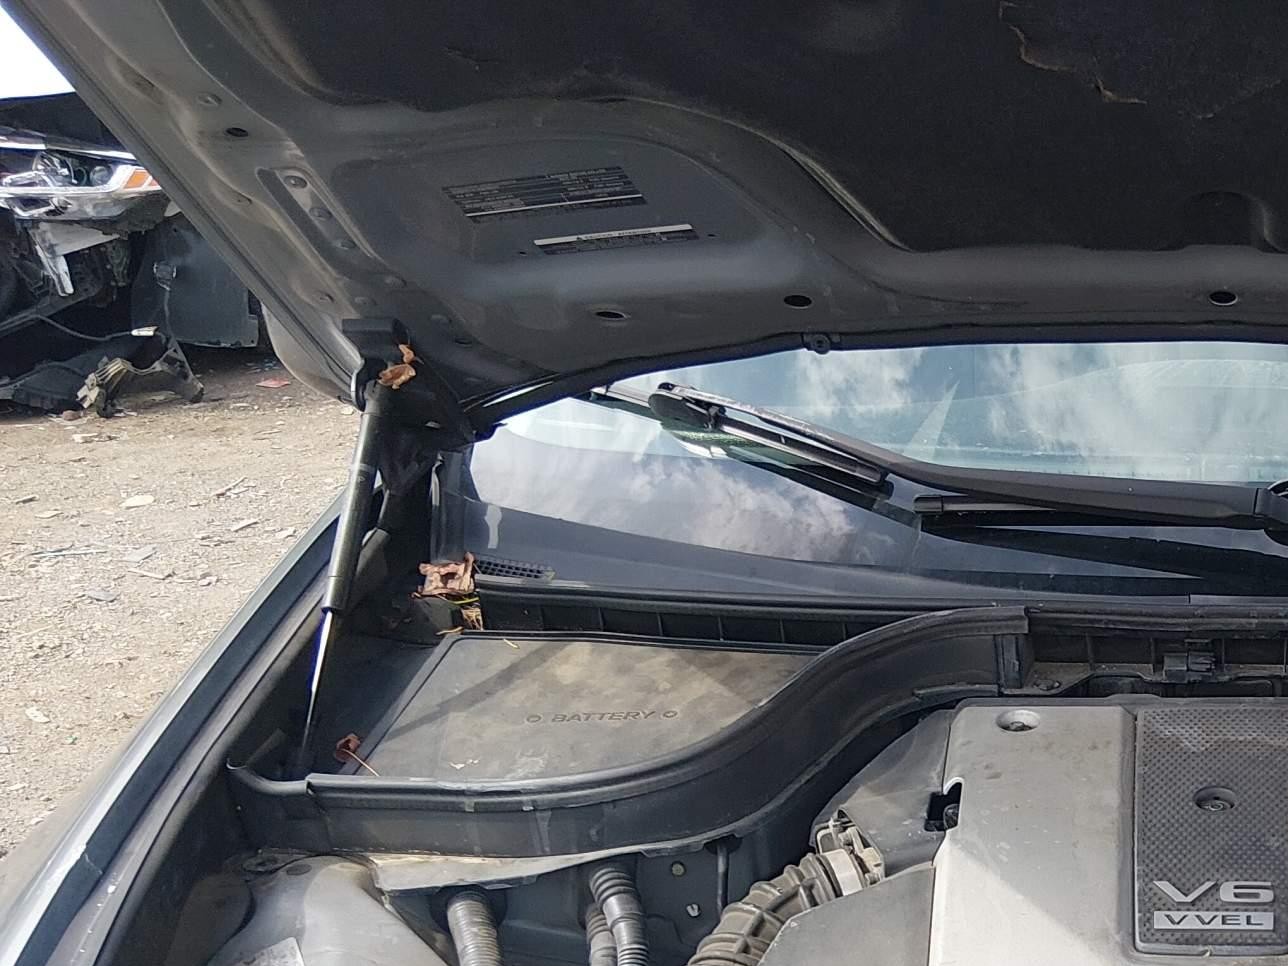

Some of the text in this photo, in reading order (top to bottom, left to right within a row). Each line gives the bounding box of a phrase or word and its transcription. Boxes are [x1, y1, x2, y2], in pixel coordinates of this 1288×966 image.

[552, 710, 656, 723] BATTERY
[1153, 880, 1274, 902] V6
[1164, 914, 1264, 925] VVEL
